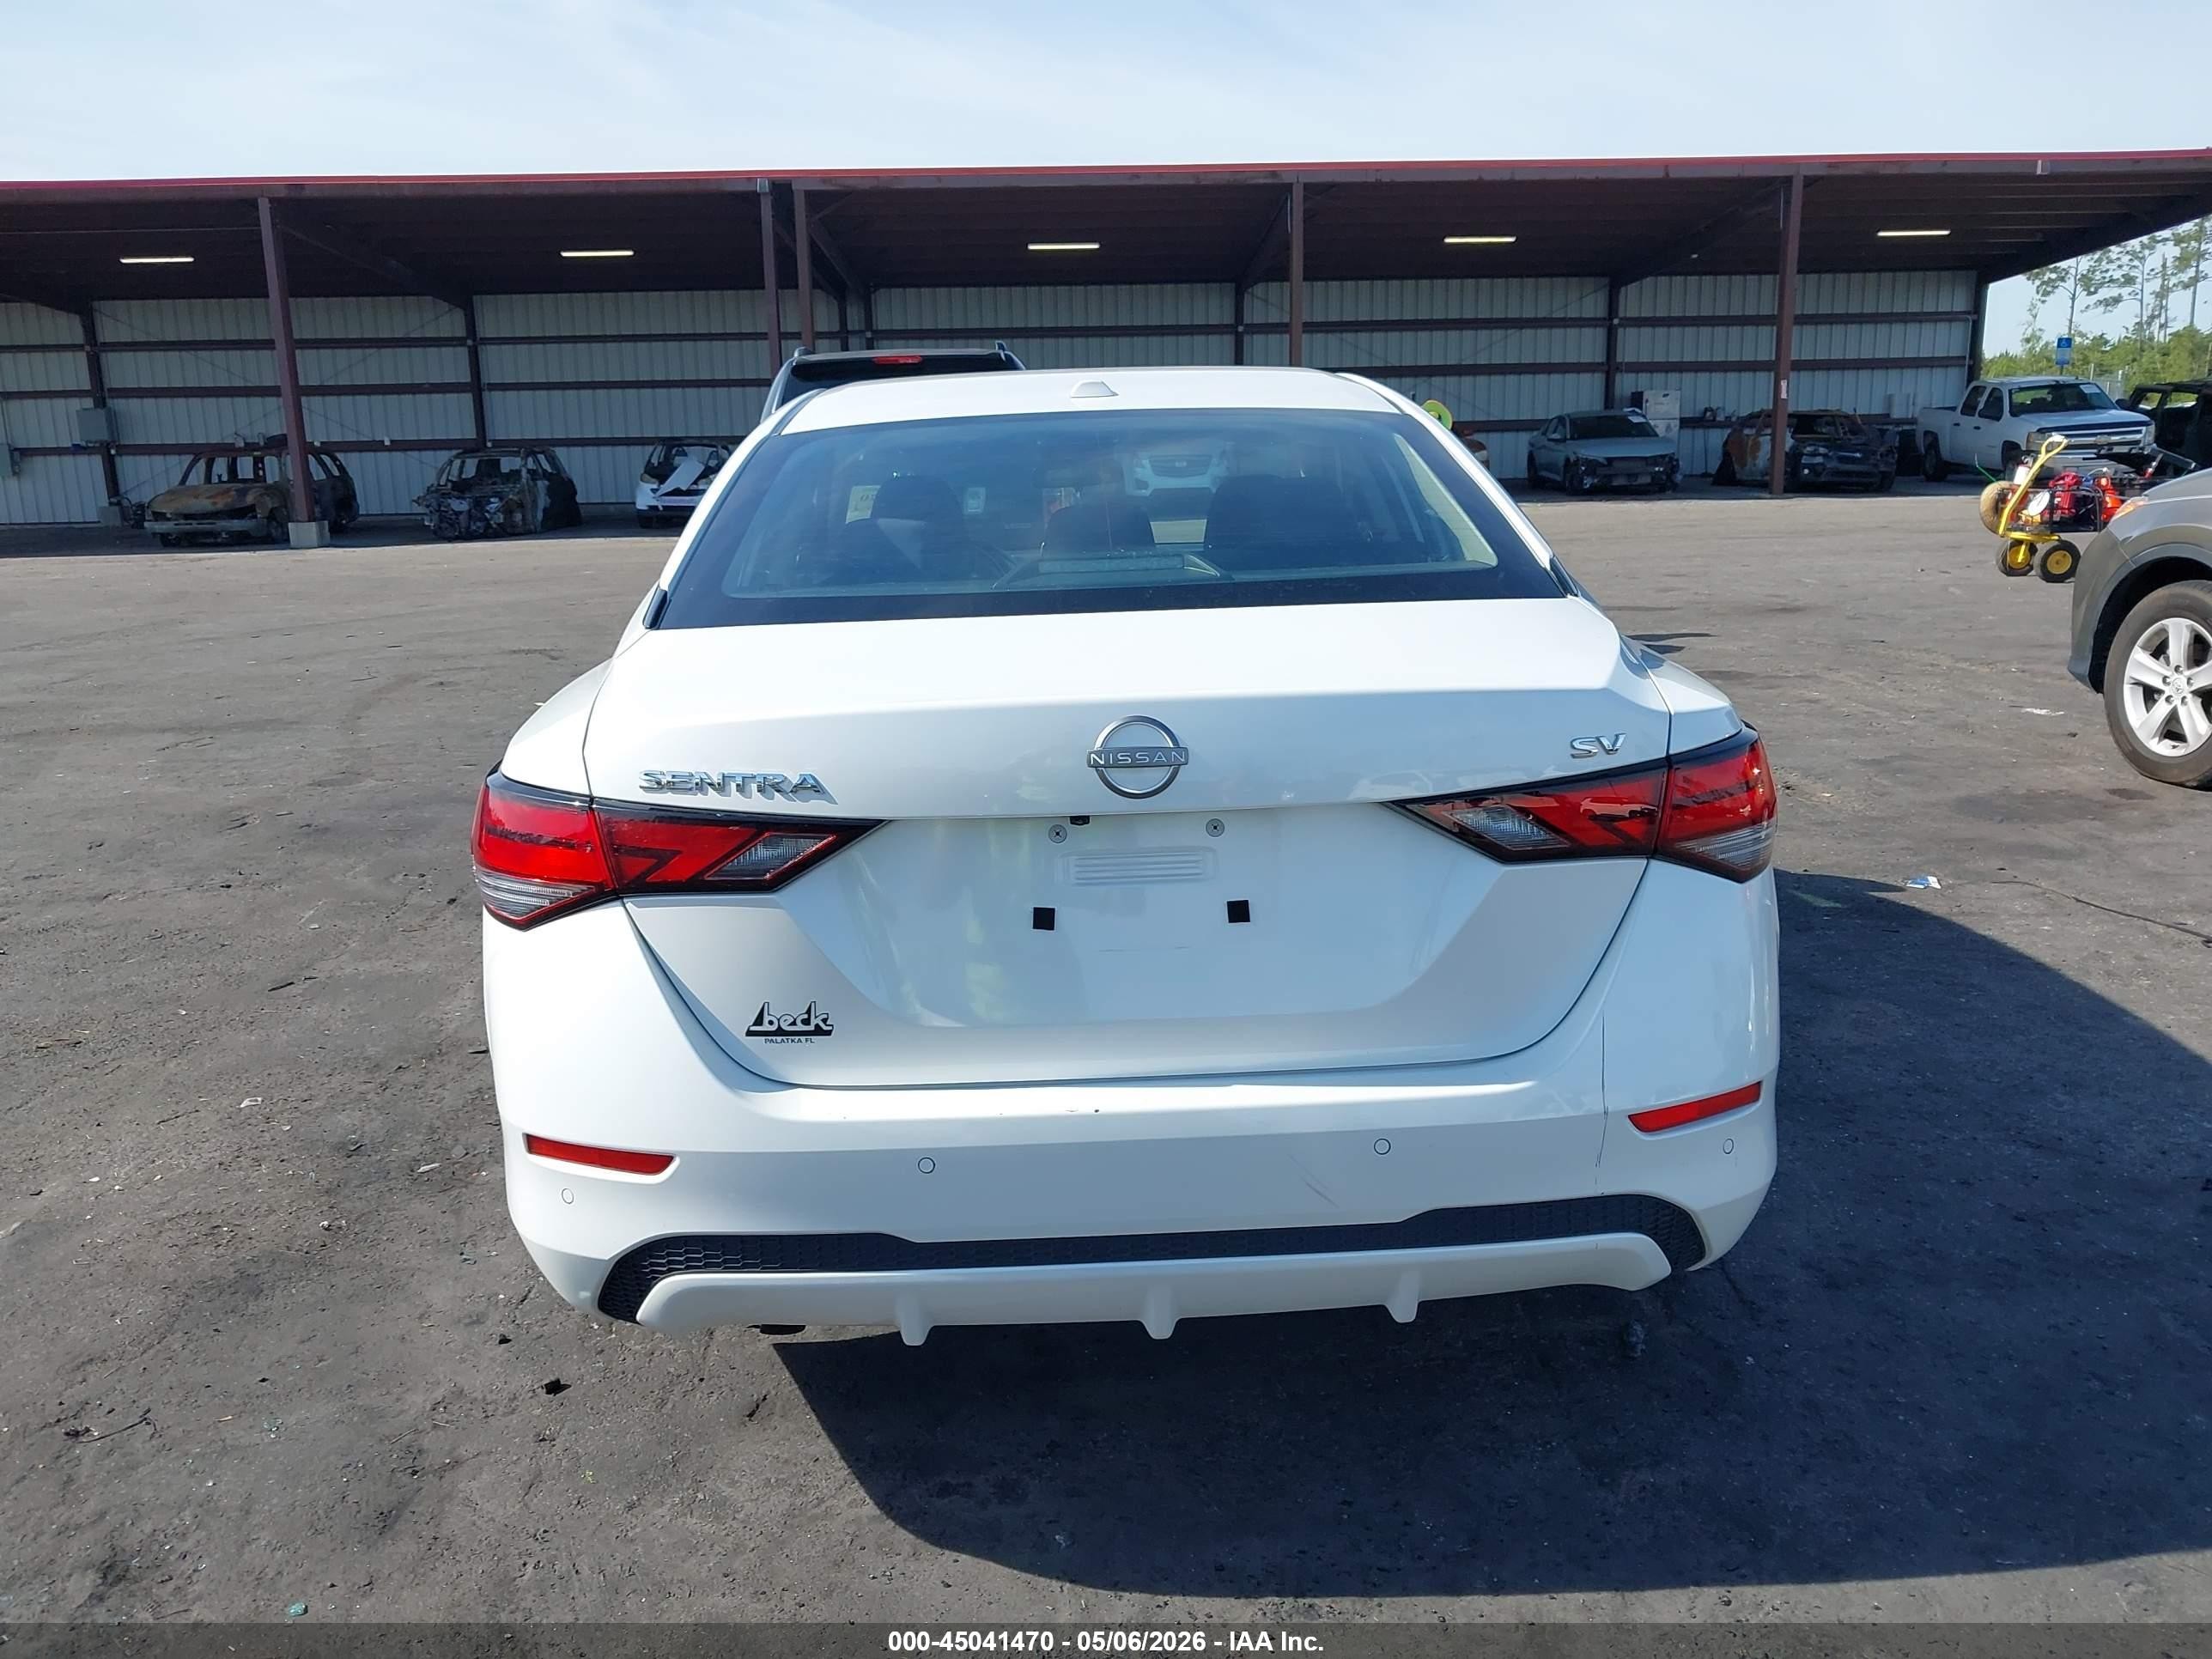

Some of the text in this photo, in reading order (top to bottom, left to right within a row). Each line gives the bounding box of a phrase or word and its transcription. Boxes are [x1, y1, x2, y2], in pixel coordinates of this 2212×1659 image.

[1090, 750, 1186, 765] NISSAN
[1570, 732, 1627, 759] SV
[639, 770, 830, 799] SENTRA
[747, 1001, 834, 1034] beck
